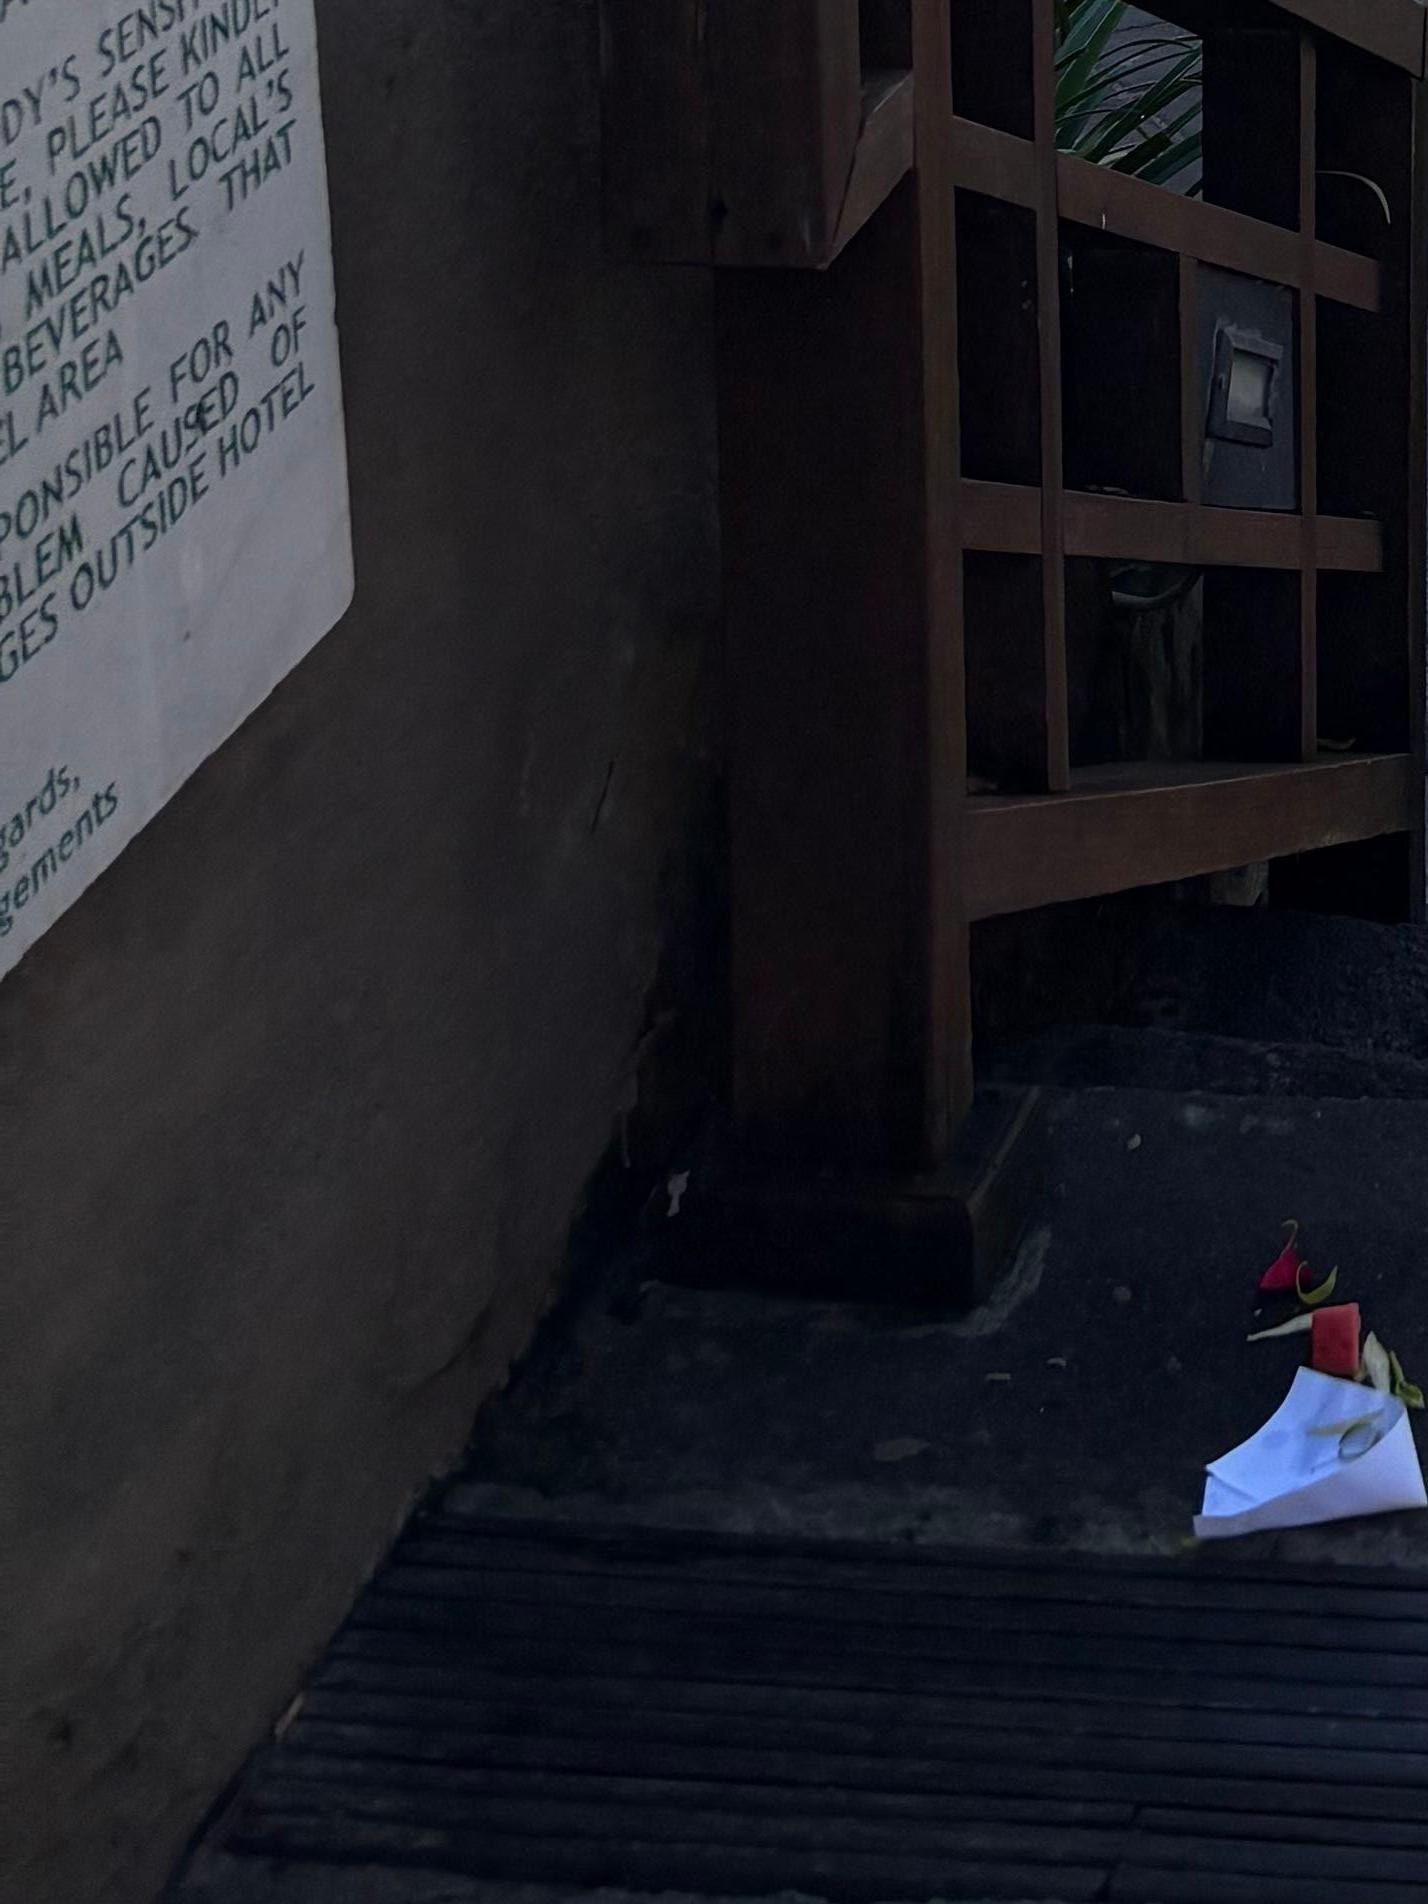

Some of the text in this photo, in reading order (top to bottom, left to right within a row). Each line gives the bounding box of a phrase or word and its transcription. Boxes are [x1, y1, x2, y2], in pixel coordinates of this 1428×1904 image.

[1, 22, 291, 277] ALLOWED TO ALL
[25, 68, 296, 324] MEALS, LOCAL'S
[46, 49, 170, 176] PLEASE
[2, 118, 299, 400] BEVERAGES THAT
[169, 318, 234, 405] FOR
[248, 248, 306, 340] ANY
[36, 328, 125, 435] AREA
[70, 450, 211, 612] OUTSIDE
[218, 361, 317, 480] HOTEL
[116, 369, 241, 511] CAUSED
[270, 305, 309, 368] OF
